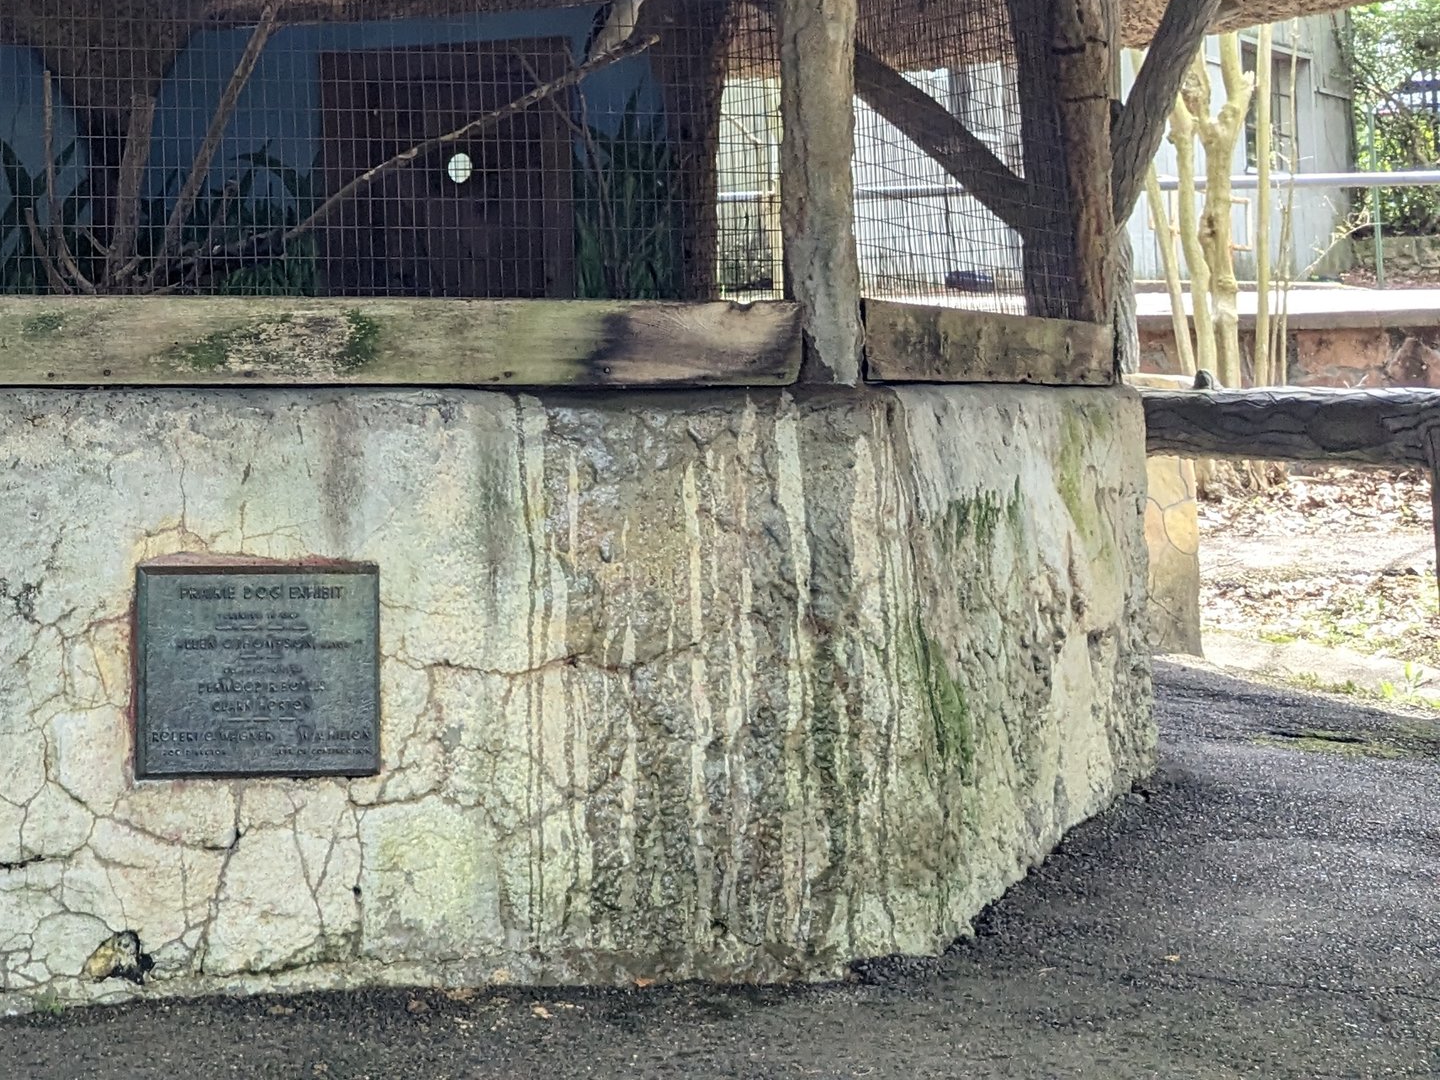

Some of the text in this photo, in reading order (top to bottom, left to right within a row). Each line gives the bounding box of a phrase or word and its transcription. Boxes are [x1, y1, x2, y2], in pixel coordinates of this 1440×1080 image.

[179, 585, 345, 600] PRAIRIE DOG EXHIBIT
